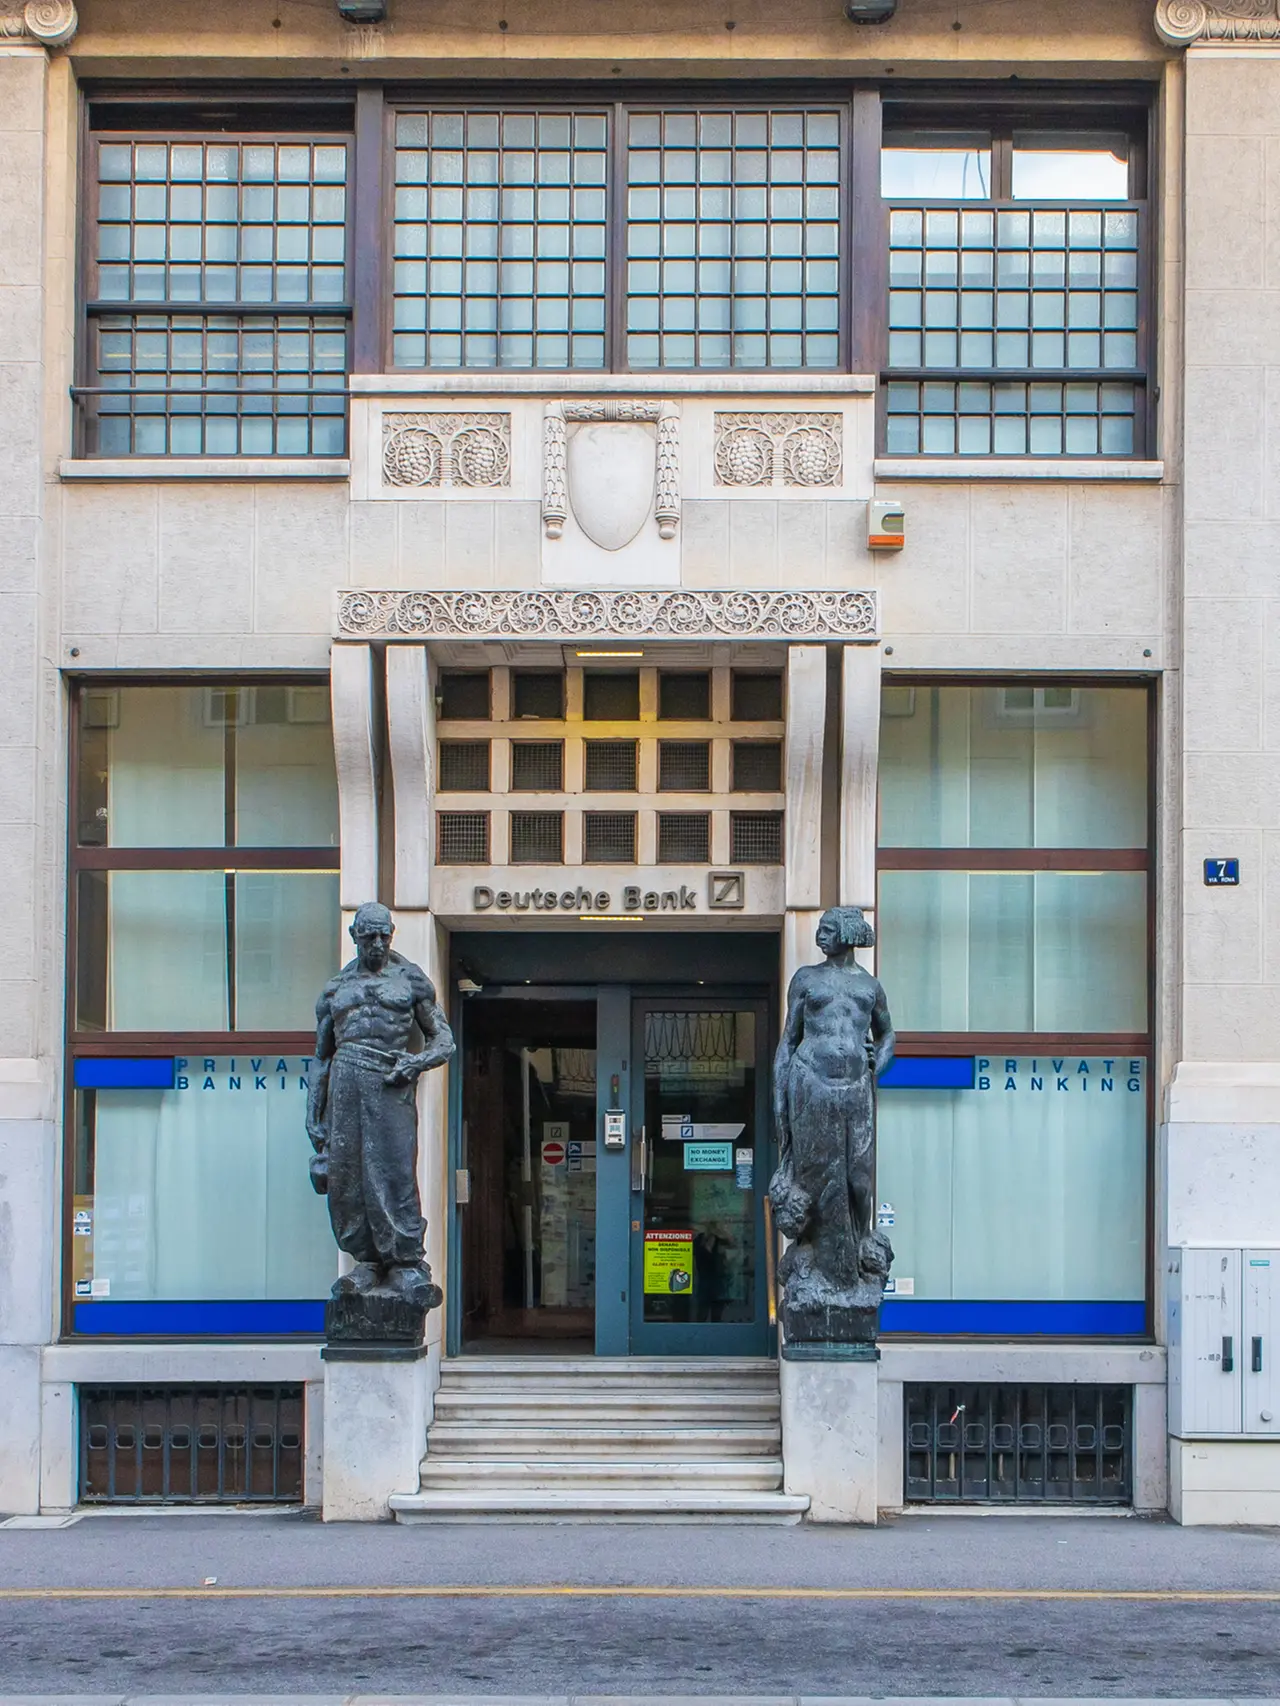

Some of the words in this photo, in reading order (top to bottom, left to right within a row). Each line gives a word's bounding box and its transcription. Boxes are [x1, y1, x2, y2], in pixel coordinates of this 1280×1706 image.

[1216, 860, 1227, 877] 7
[474, 886, 610, 910] Deutsche
[623, 886, 697, 910] Bank
[176, 1058, 313, 1073] PRIVAT
[978, 1059, 1141, 1075] PRIVATE
[176, 1076, 311, 1090] BANKIN
[978, 1077, 1141, 1092] BANKING
[645, 1232, 693, 1240] ATTENZIONE!
